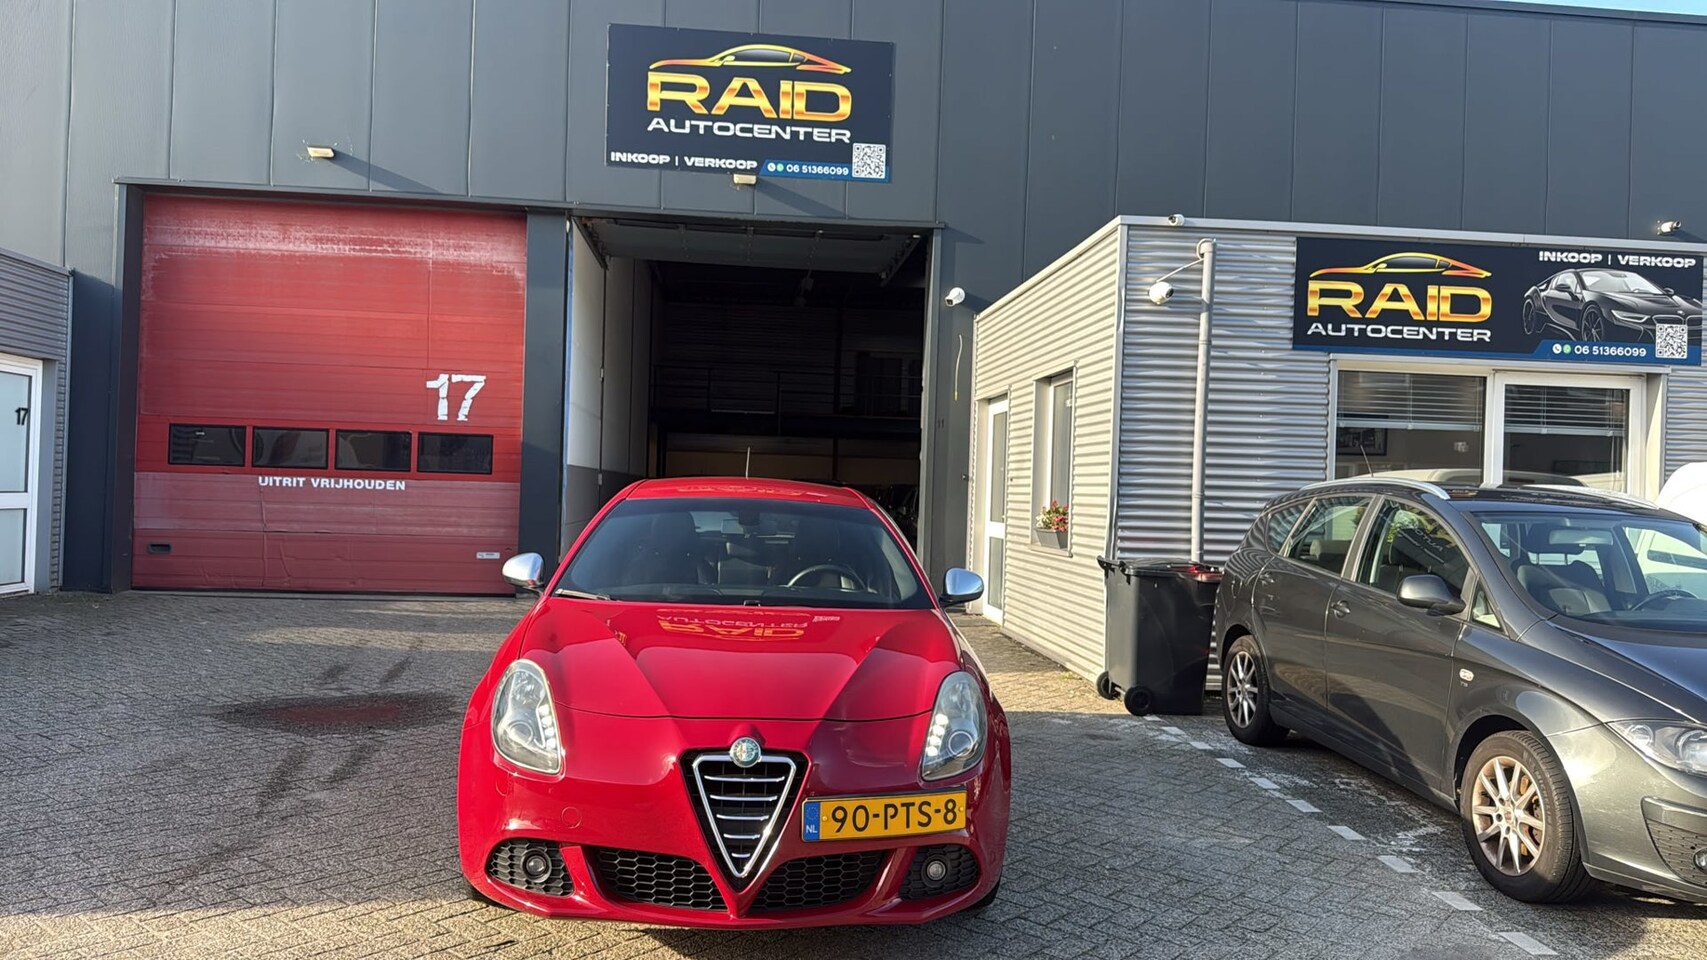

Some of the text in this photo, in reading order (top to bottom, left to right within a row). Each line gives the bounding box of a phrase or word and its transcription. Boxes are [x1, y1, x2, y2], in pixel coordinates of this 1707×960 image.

[647, 71, 852, 121] RAID
[647, 117, 851, 143] AUTOCENTER
[610, 151, 671, 165] INKOOP
[684, 156, 758, 170] VERKOOP
[786, 163, 849, 176] 06 51366099
[1538, 250, 1602, 264] INKOOP
[1617, 254, 1696, 268] VERKOOP
[1306, 279, 1493, 323] RAID
[1306, 322, 1492, 343] AUTOCENTER
[1573, 344, 1647, 357] 06 51366099
[425, 373, 487, 421] 17
[14, 407, 29, 425] 17
[258, 476, 406, 490] UITRIT VRIJHOUDEN
[831, 798, 958, 833] 90-PTS-8
[805, 824, 818, 834] NL
